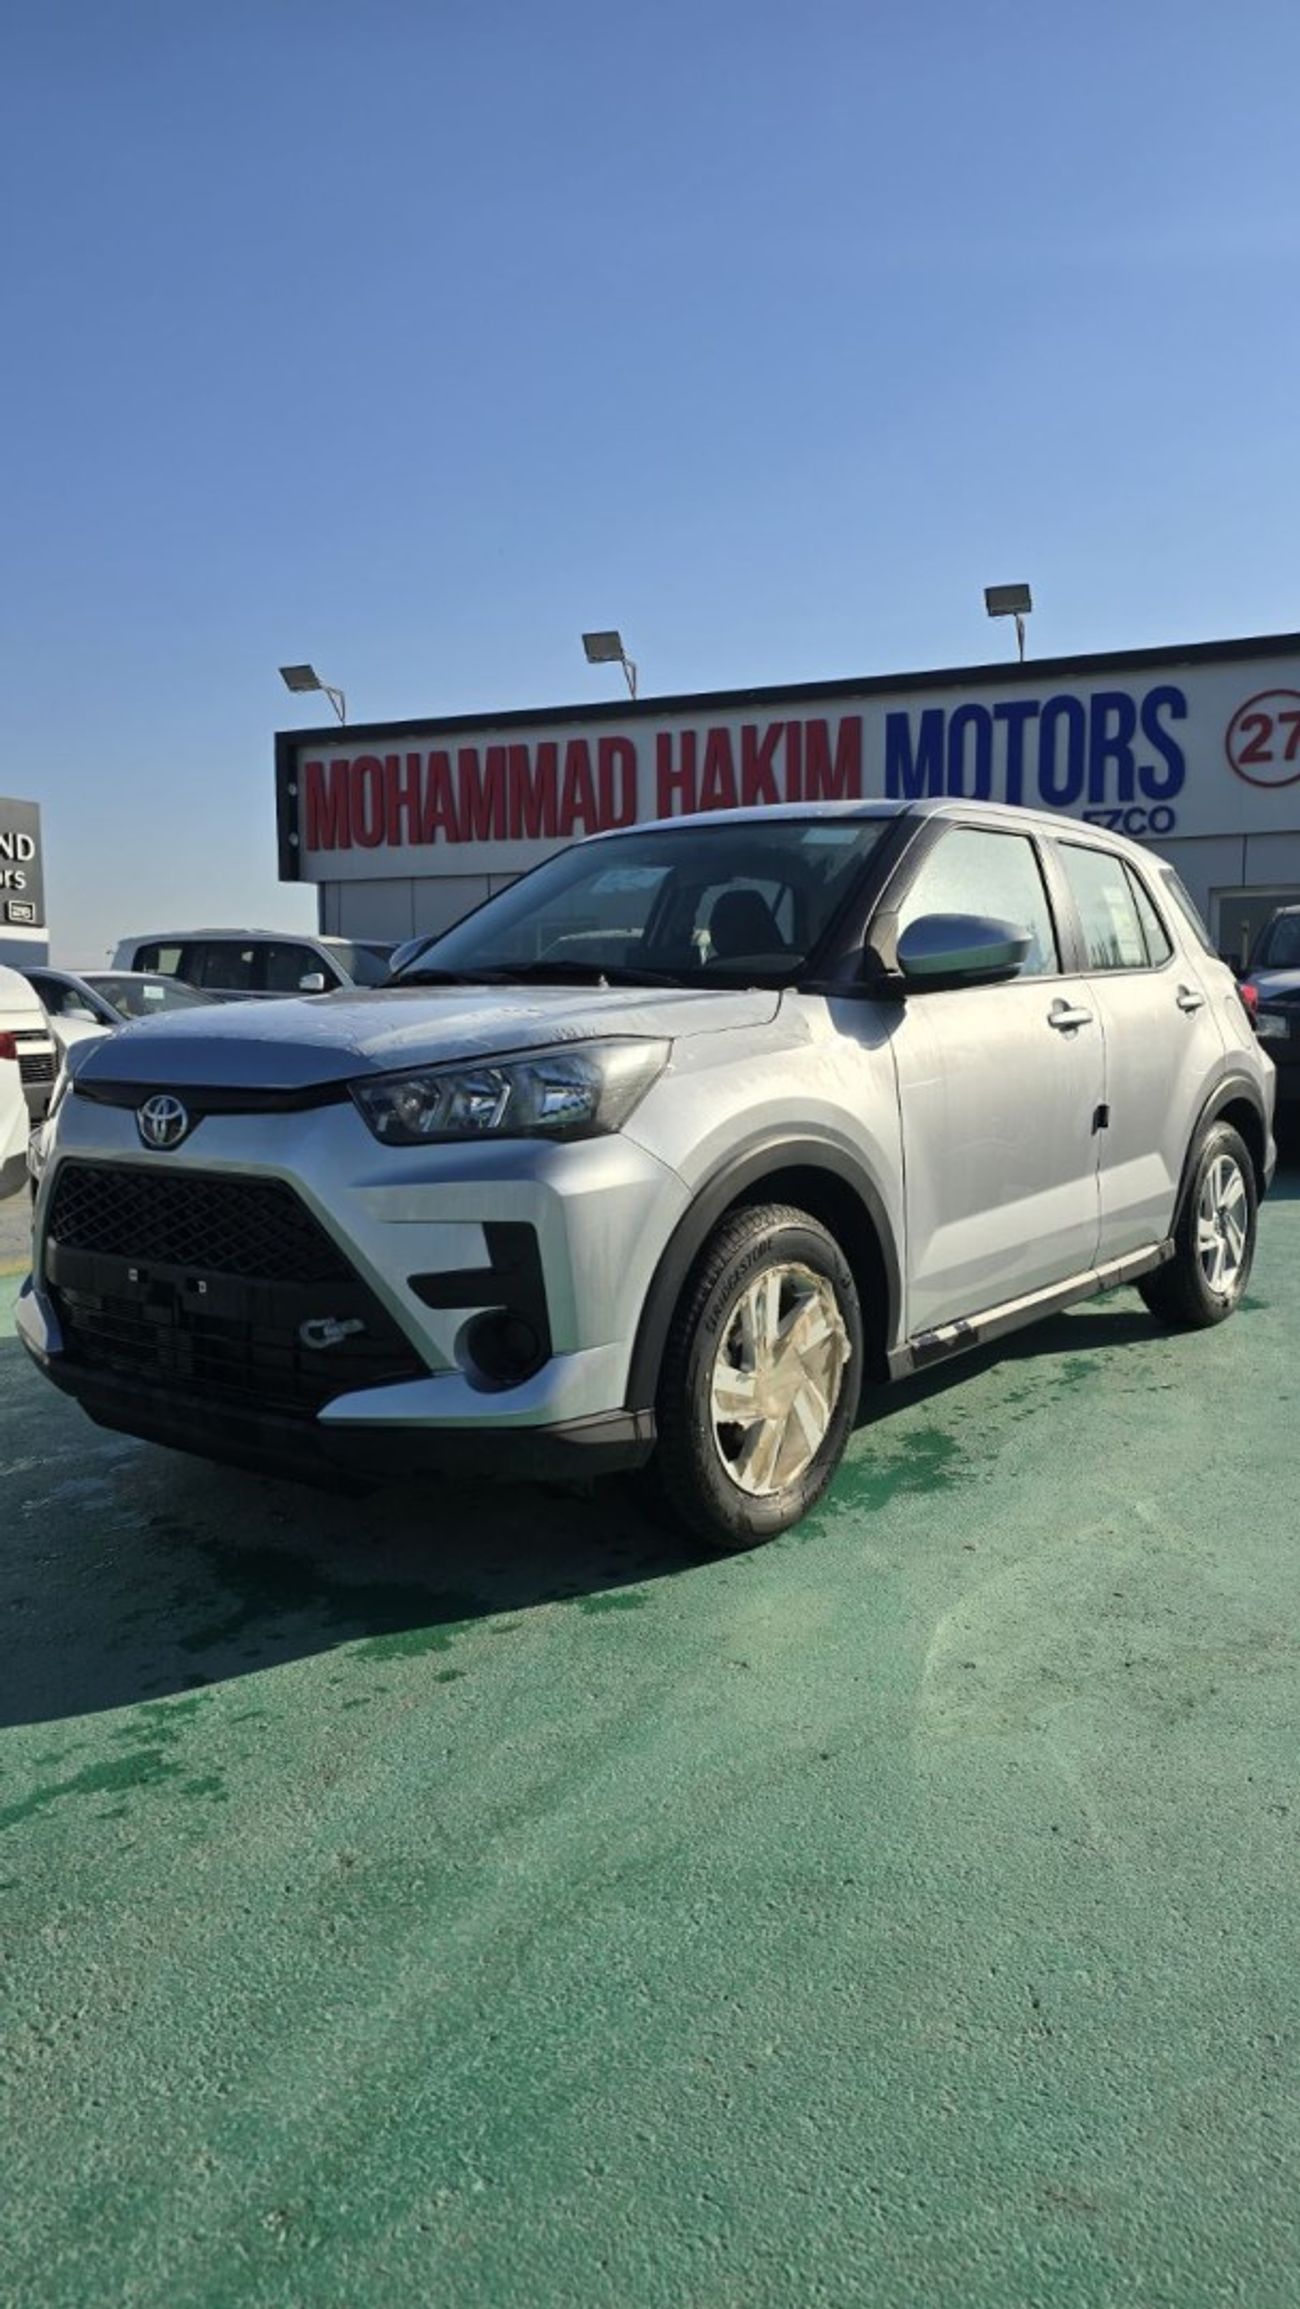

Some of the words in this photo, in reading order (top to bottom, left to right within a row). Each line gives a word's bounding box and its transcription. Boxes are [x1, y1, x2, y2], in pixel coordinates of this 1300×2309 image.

[304, 736, 638, 852] MOHAMMAD
[656, 715, 863, 820] HAKIM
[884, 684, 1188, 807] MOTORS
[0, 869, 26, 889] rs
